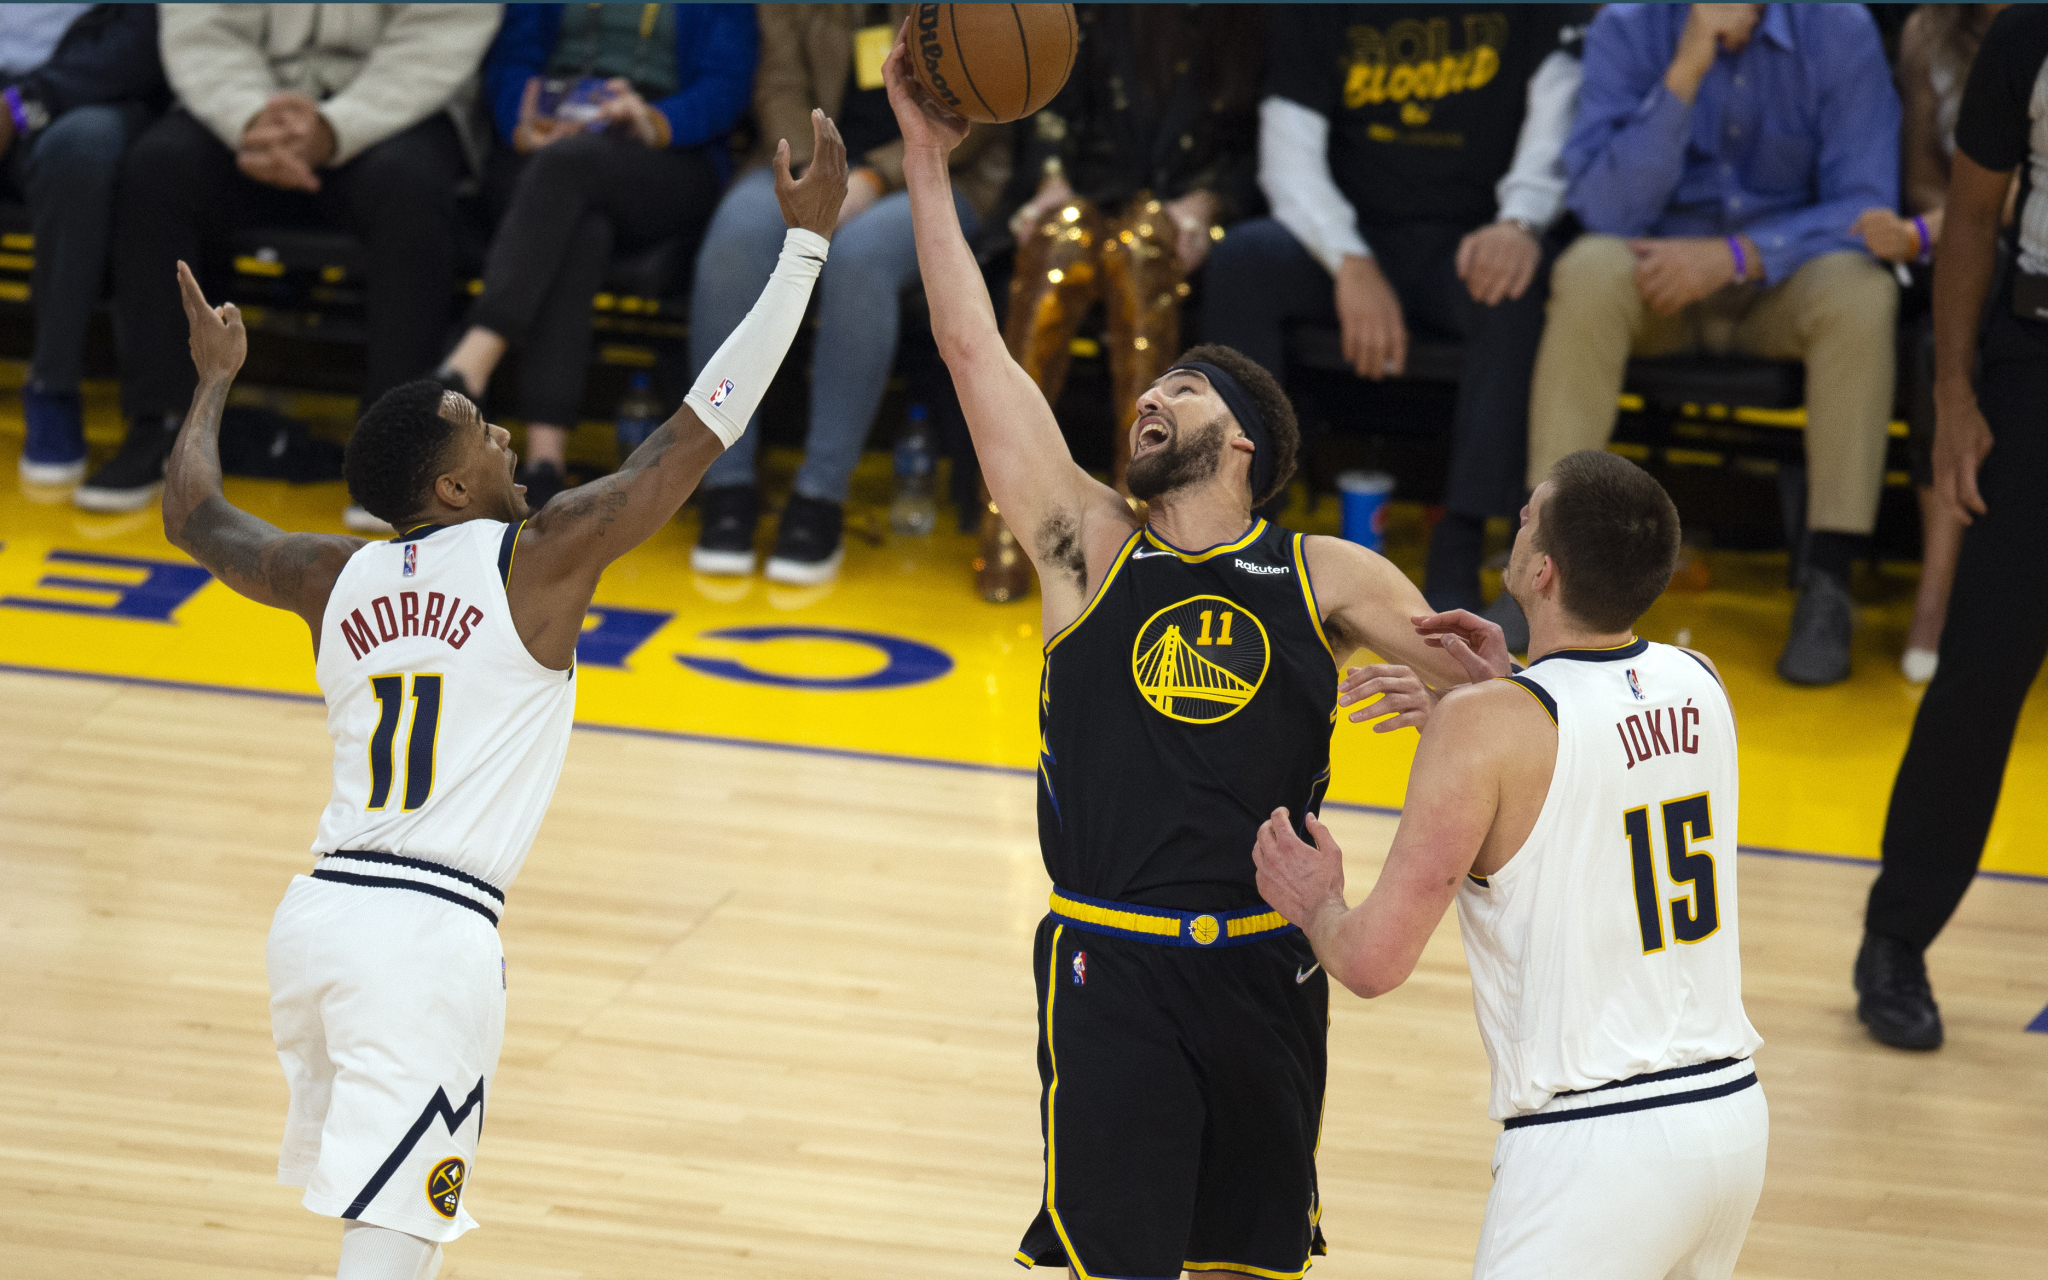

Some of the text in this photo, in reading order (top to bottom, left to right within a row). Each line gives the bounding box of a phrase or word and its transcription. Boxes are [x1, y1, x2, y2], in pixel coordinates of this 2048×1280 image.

[1234, 558, 1290, 575] Rakuten
[340, 591, 485, 661] MORRIS
[1196, 610, 1233, 646] 11
[364, 672, 444, 813] 11
[1616, 698, 1700, 771] JOKIĆ
[1623, 790, 1722, 957] 15
